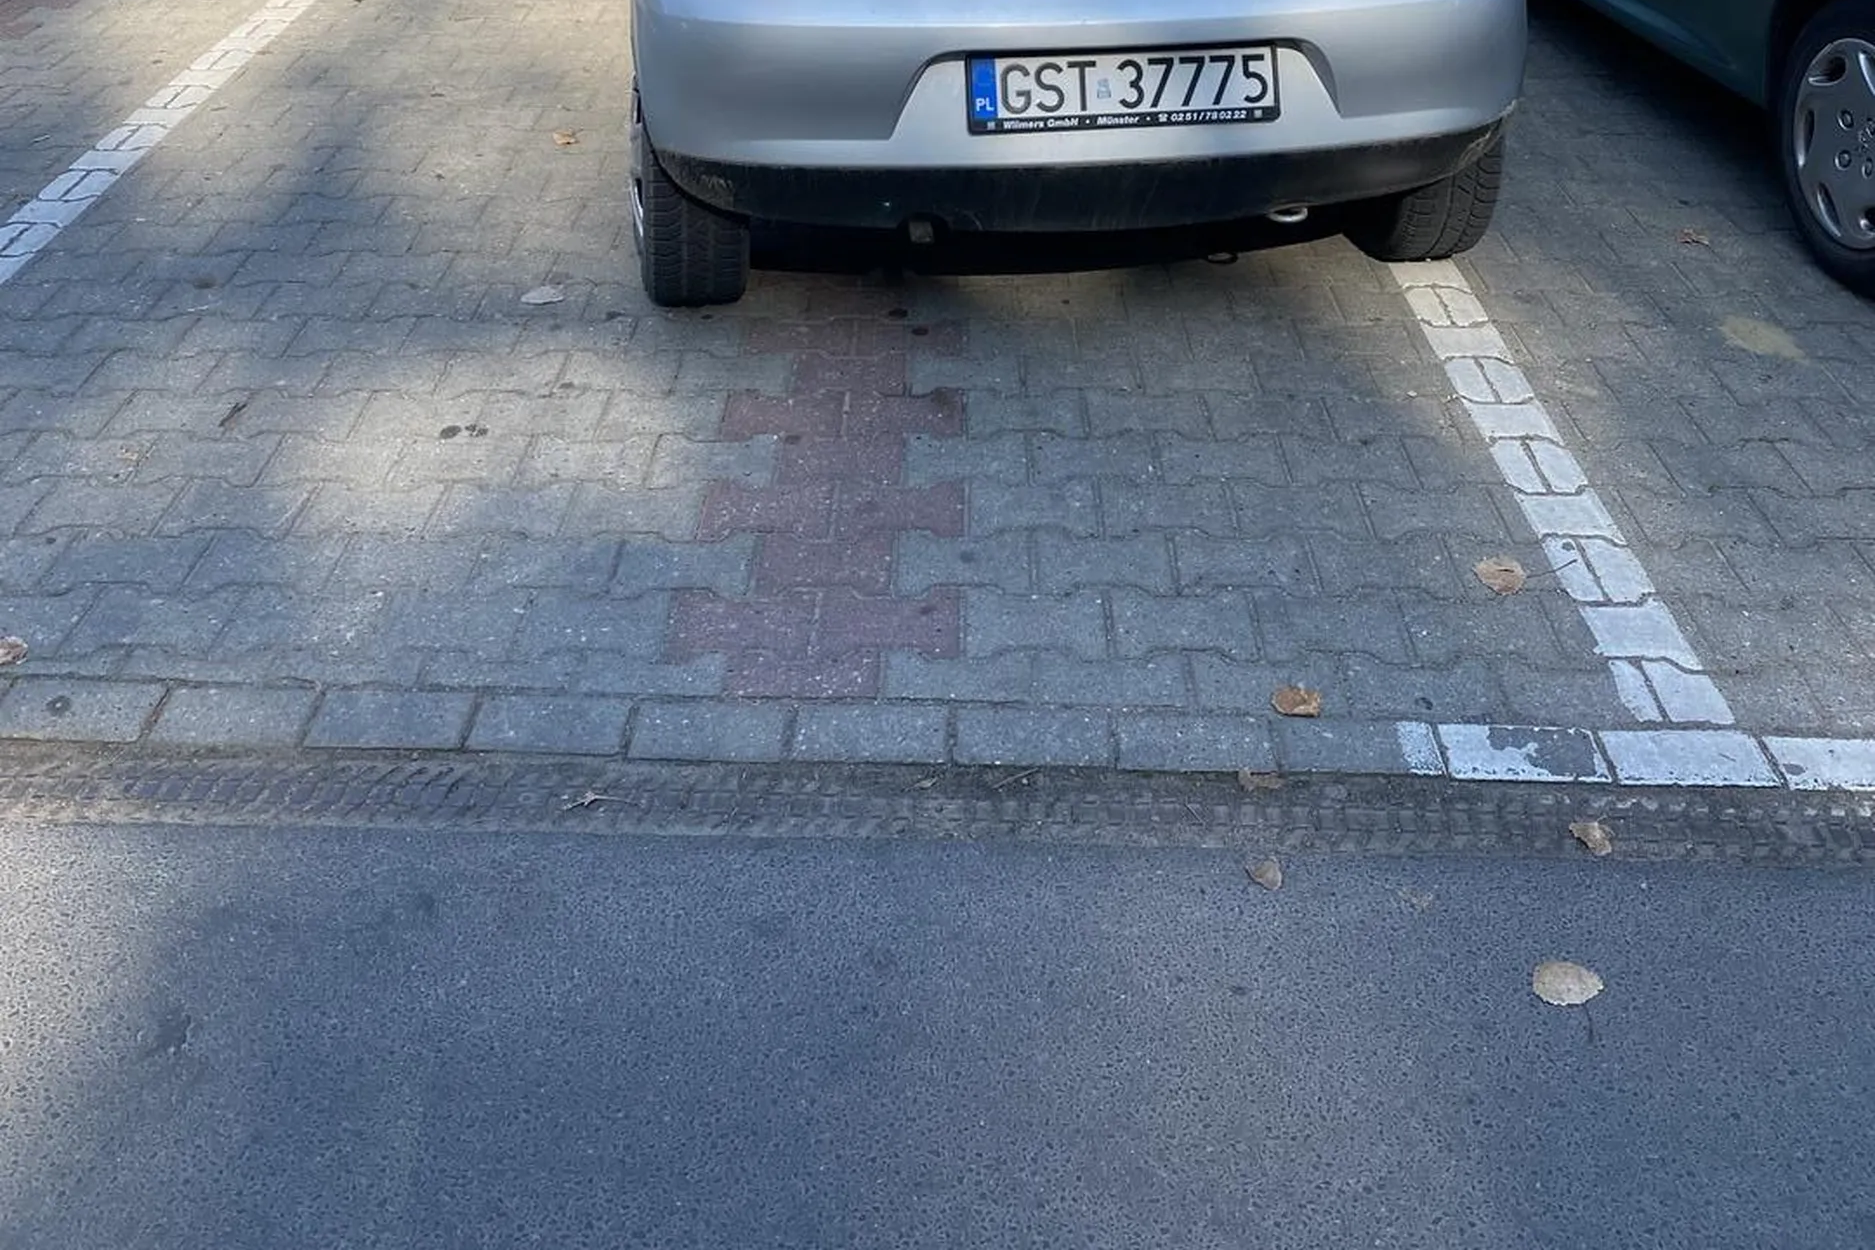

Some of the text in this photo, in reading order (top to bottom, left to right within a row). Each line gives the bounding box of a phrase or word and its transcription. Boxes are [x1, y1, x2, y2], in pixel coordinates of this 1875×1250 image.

[1000, 54, 1269, 115] GST 37775
[975, 96, 995, 112] PL
